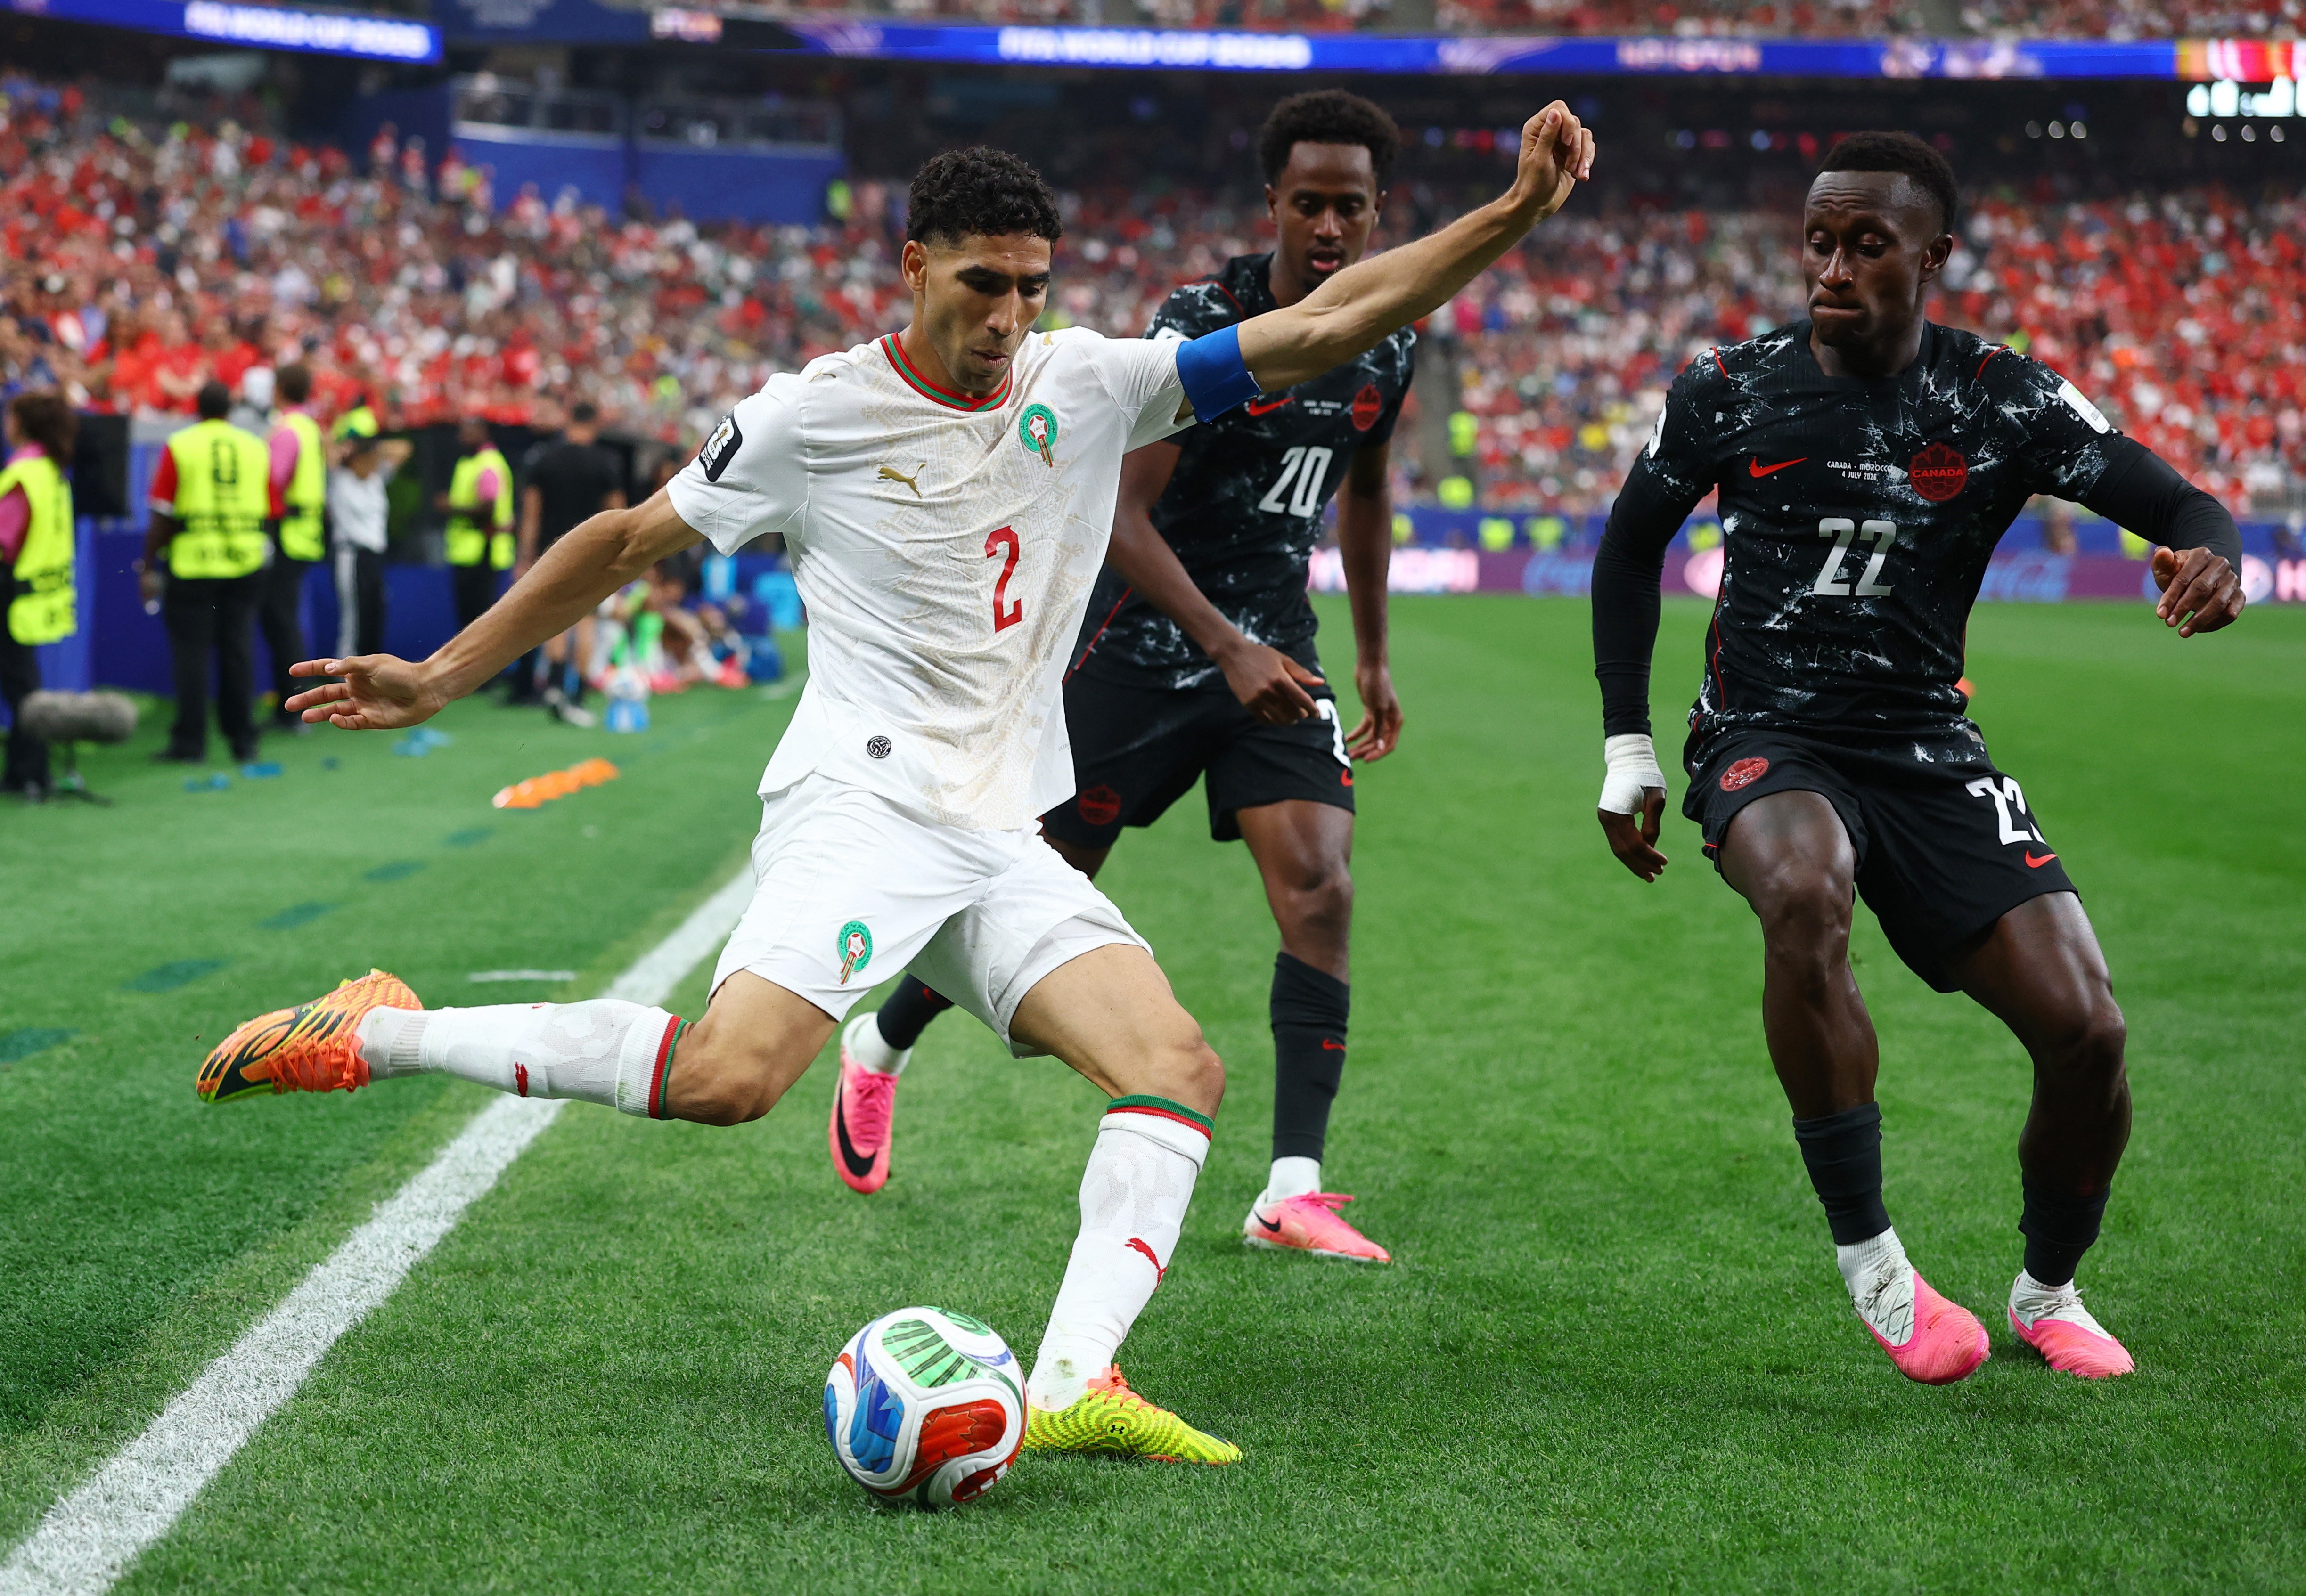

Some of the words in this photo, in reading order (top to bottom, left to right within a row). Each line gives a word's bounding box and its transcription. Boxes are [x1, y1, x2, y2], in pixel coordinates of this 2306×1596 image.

[1258, 446, 1333, 518] 20
[1827, 461, 1852, 470] CANADA
[1859, 463, 1893, 472] MOROCCO
[1848, 471, 1862, 479] JULY
[1864, 472, 1877, 480] 2026
[1912, 468, 1964, 478] CANADA
[1814, 518, 1897, 596] 22
[984, 525, 1022, 633] 2
